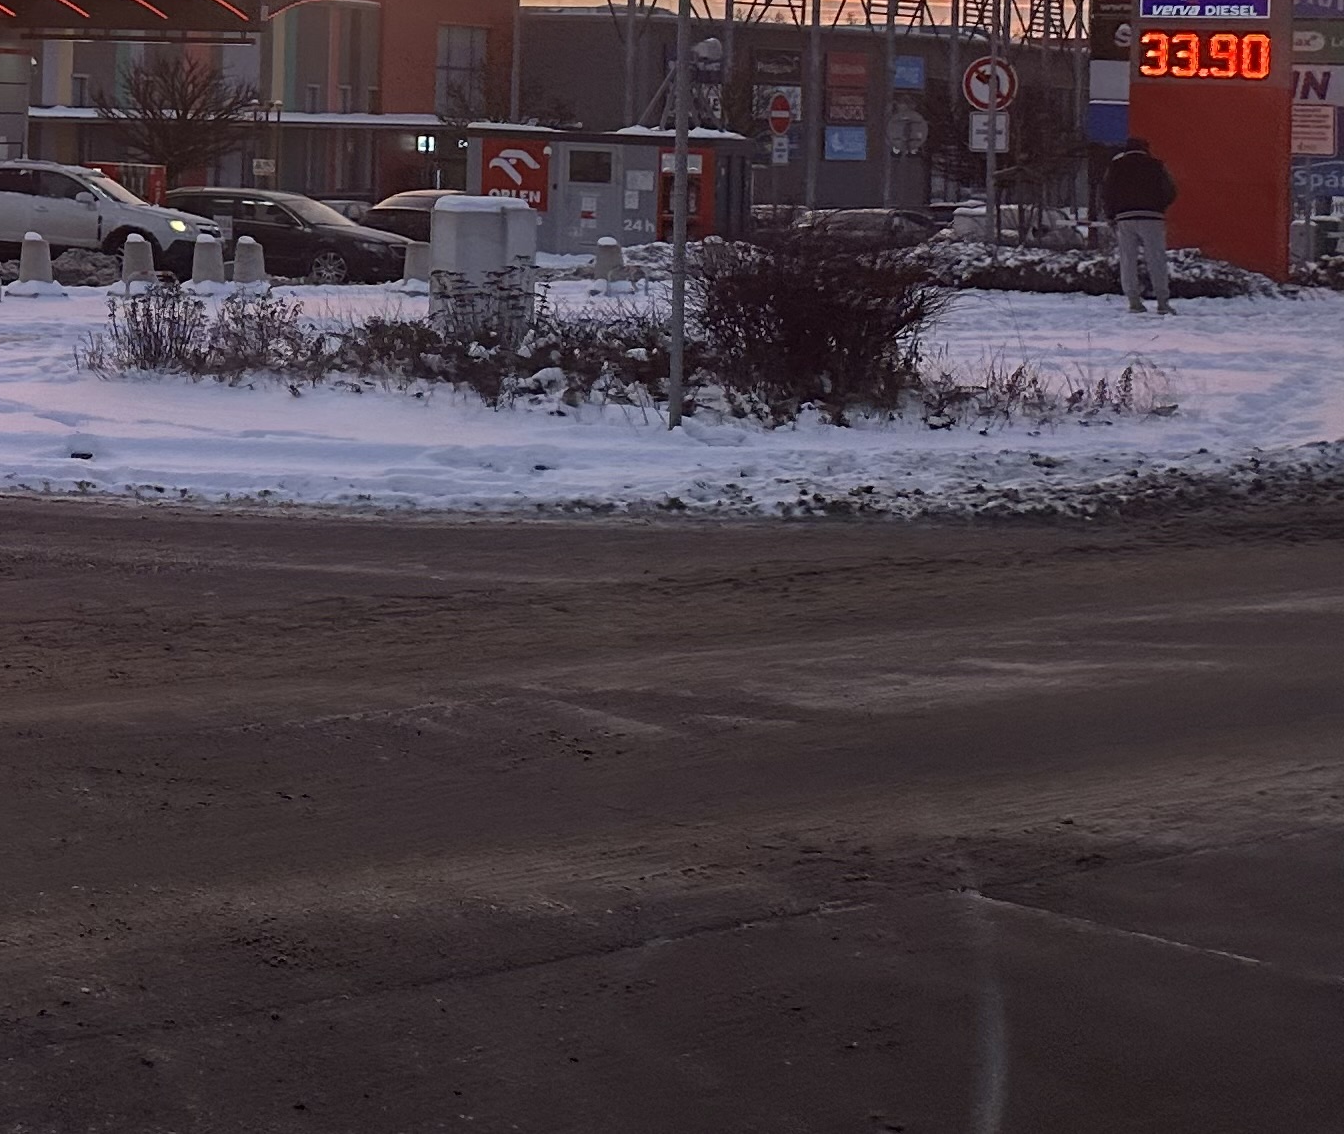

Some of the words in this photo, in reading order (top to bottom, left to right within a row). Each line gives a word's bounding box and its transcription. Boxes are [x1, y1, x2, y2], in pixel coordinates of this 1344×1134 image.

[1152, 4, 1201, 16] verva
[1204, 4, 1257, 16] DIESEL
[1140, 33, 1271, 79] 33.90
[623, 219, 642, 232] 24
